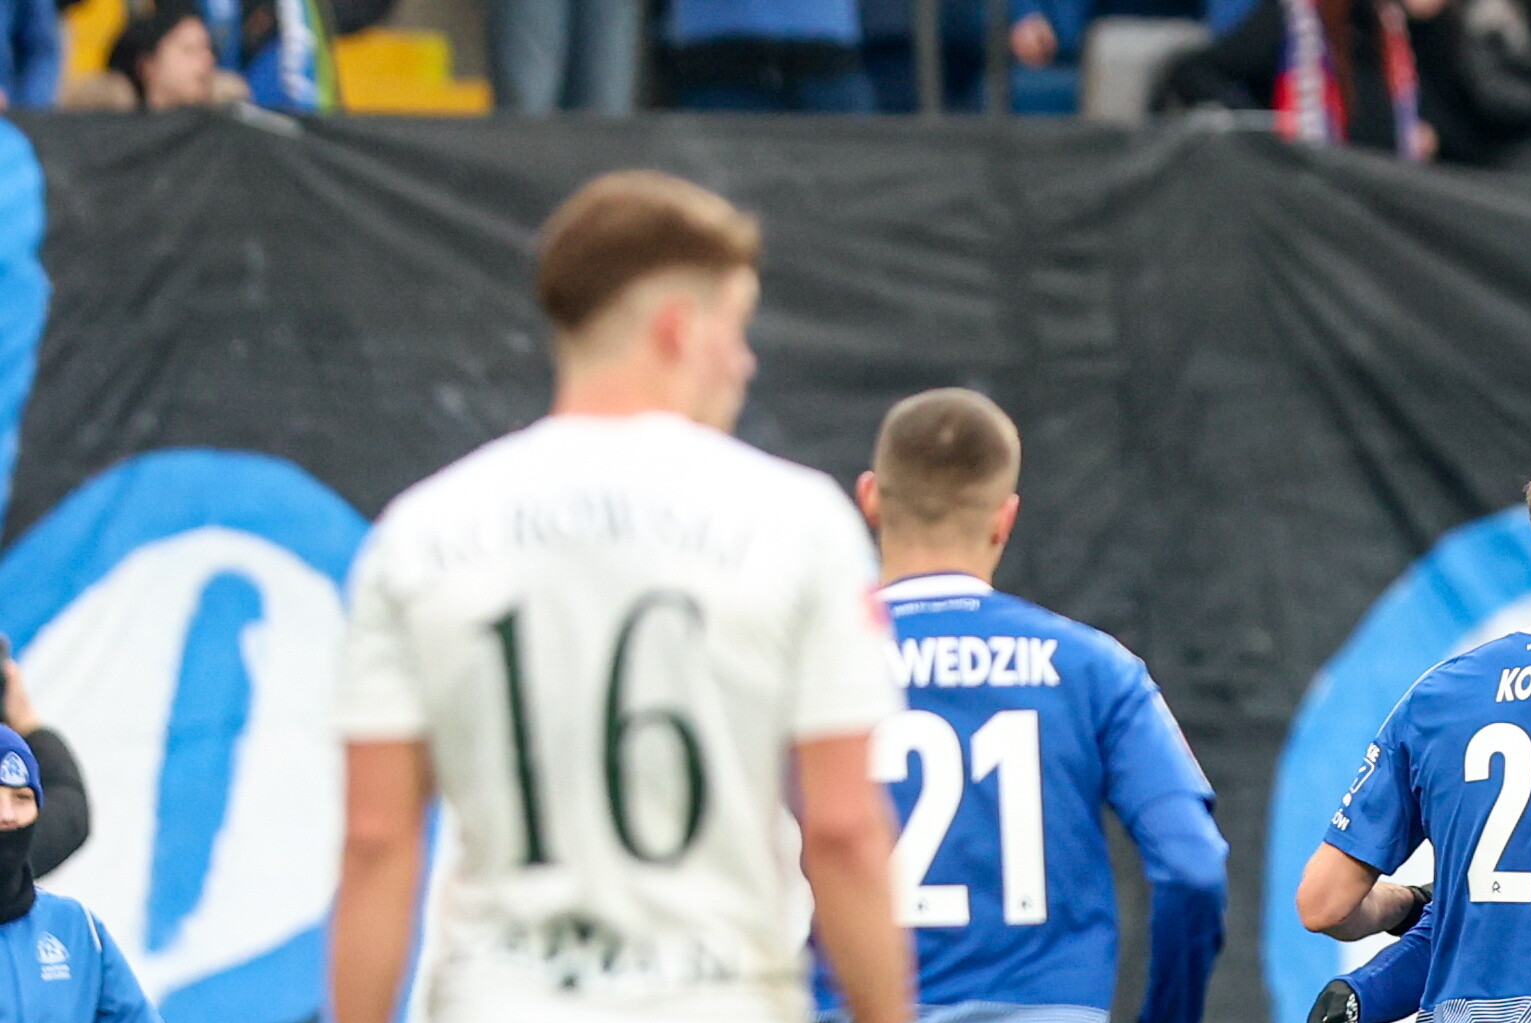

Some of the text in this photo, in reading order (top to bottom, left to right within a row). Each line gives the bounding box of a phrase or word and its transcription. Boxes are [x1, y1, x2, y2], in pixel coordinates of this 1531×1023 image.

[474, 590, 708, 868] 16
[882, 635, 1060, 688] WEDZIK
[873, 709, 1046, 926] 21
